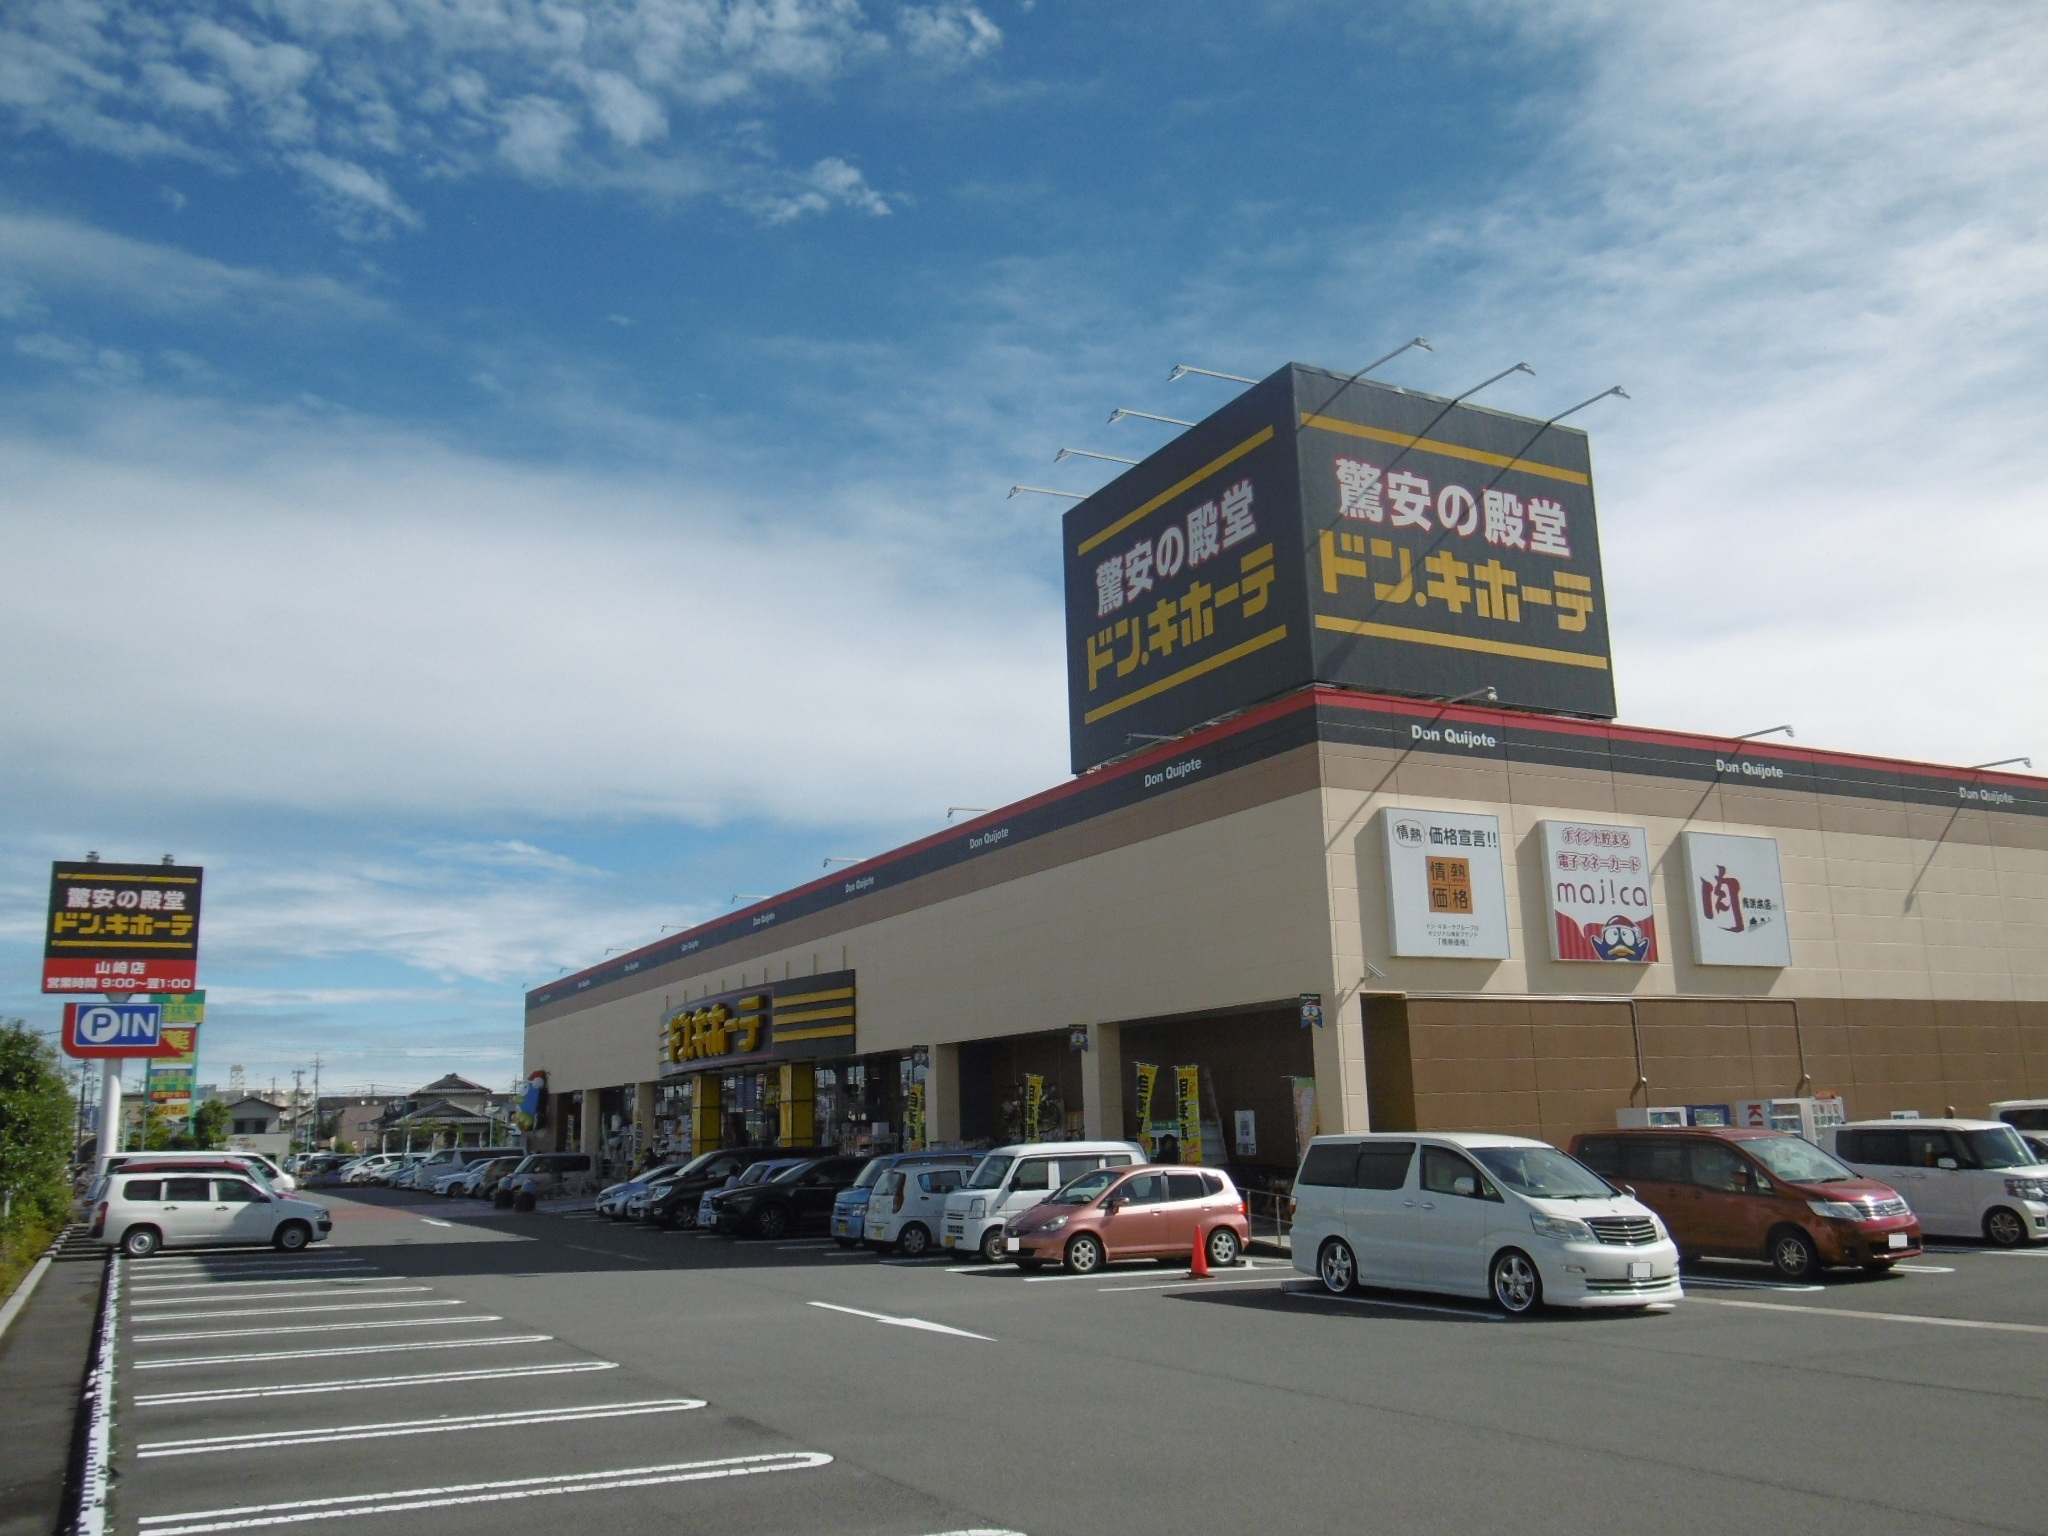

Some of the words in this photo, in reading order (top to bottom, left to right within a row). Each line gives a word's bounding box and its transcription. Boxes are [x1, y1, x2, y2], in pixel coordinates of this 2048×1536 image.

[1335, 458, 1571, 557] 驚安の殿堂
[1096, 480, 1256, 616] 驚安の殿堂
[1411, 724, 1440, 741] Don
[1444, 728, 1496, 748] Quijote
[1145, 774, 1163, 787] Don
[1166, 759, 1202, 779] Quijote
[1716, 759, 1739, 773] Don
[1742, 762, 1783, 779] Quijote
[1959, 787, 1978, 800] Don
[1980, 789, 2014, 804] Quijote
[970, 838, 982, 849] Don
[984, 828, 1009, 843] Quijote
[1396, 824, 1422, 842] 情熱
[1563, 827, 1630, 847] ポイント貯まる
[1557, 852, 1641, 873] 電子マネーカード
[67, 887, 186, 910] 驚安の殿堂
[1700, 864, 1744, 933] 肉
